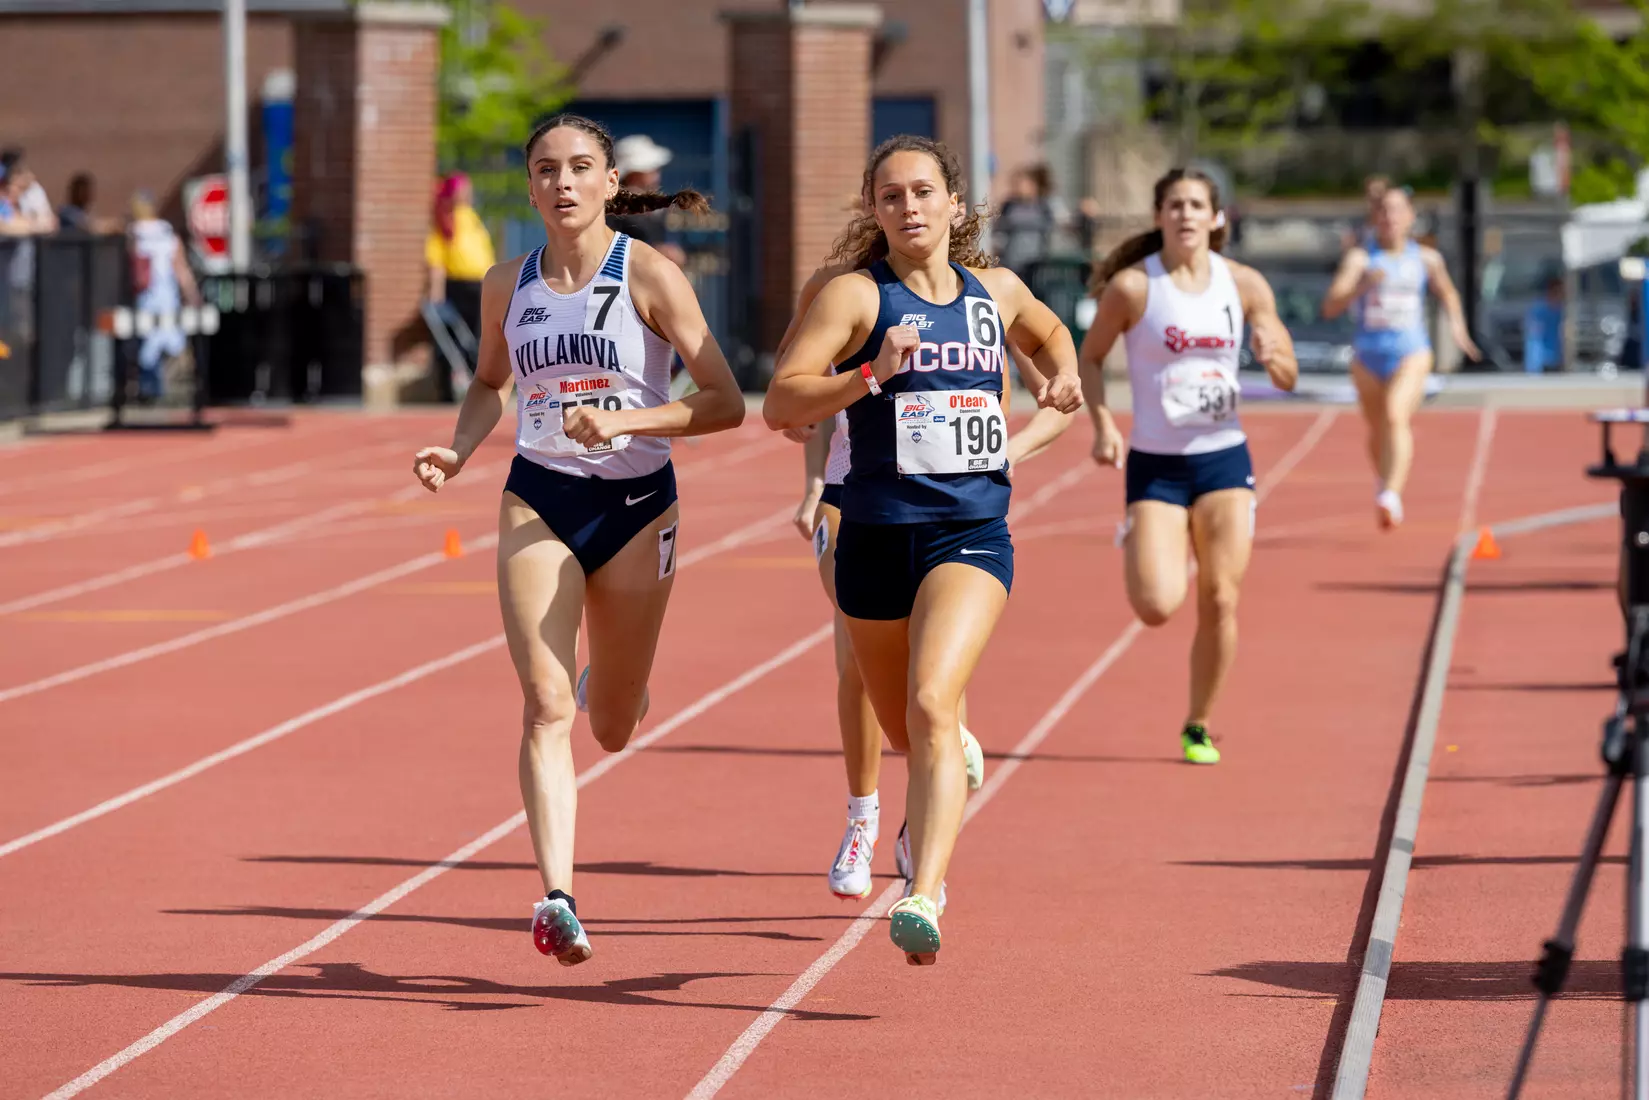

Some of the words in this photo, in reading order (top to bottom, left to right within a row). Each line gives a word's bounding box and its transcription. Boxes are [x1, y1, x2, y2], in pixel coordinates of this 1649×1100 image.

[523, 307, 547, 316] BIG
[592, 285, 621, 331] 7
[519, 314, 552, 324] EAST
[900, 313, 927, 322] BIG
[971, 301, 997, 347] 6
[1222, 304, 1234, 335] 1
[515, 333, 622, 378] VILLANOVA
[896, 341, 1004, 375] CONN
[560, 378, 610, 394] Martinez
[526, 398, 551, 407] EAST
[529, 392, 547, 400] BIG
[949, 395, 988, 409] O'Leary
[903, 404, 927, 412] BIG
[949, 414, 1003, 456] 196
[662, 524, 677, 574] 7
